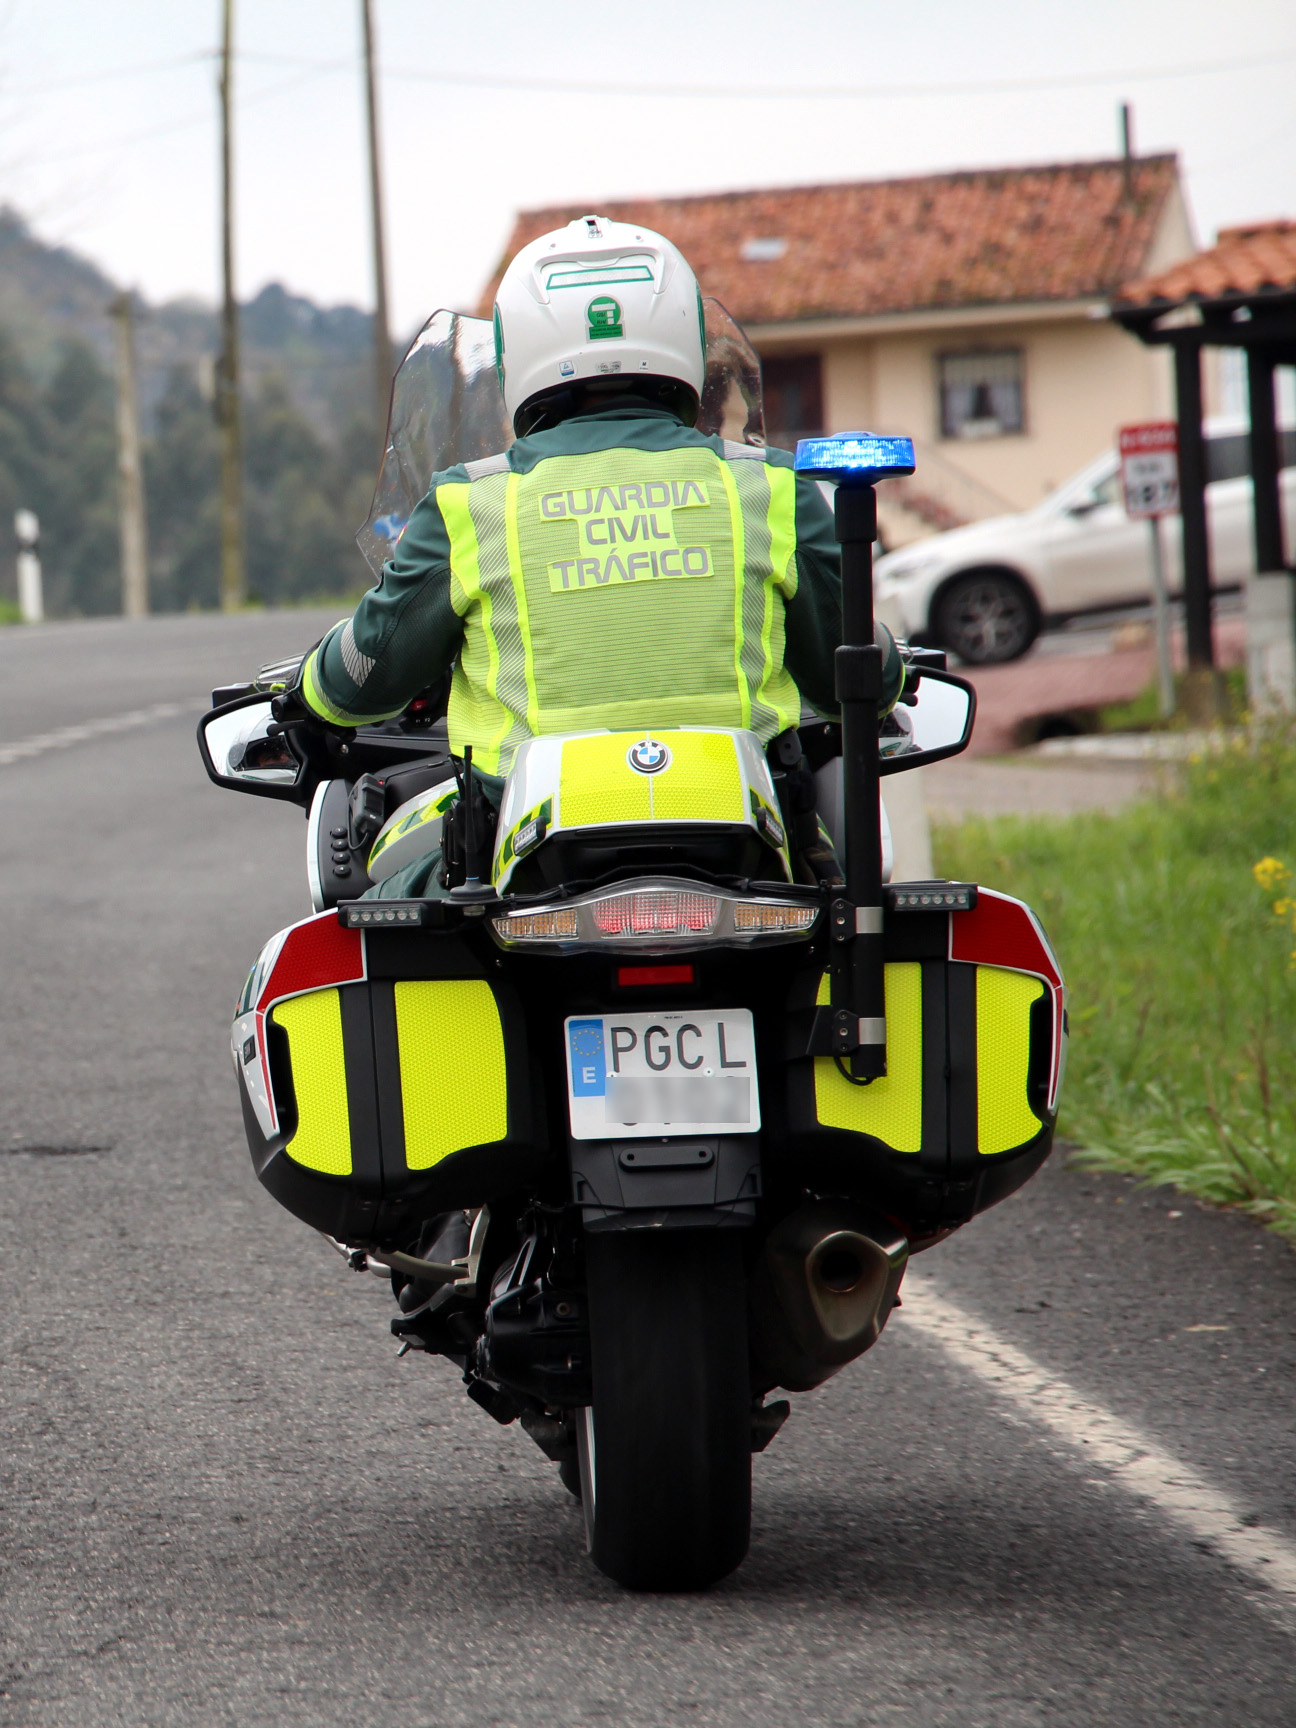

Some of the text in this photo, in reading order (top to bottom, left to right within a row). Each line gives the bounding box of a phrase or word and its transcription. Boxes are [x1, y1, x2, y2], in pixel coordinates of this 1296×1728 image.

[541, 480, 706, 518] GUARDIA
[585, 513, 671, 546] CIVIL
[553, 547, 709, 589] TRÁFICO
[582, 1066, 597, 1084] E
